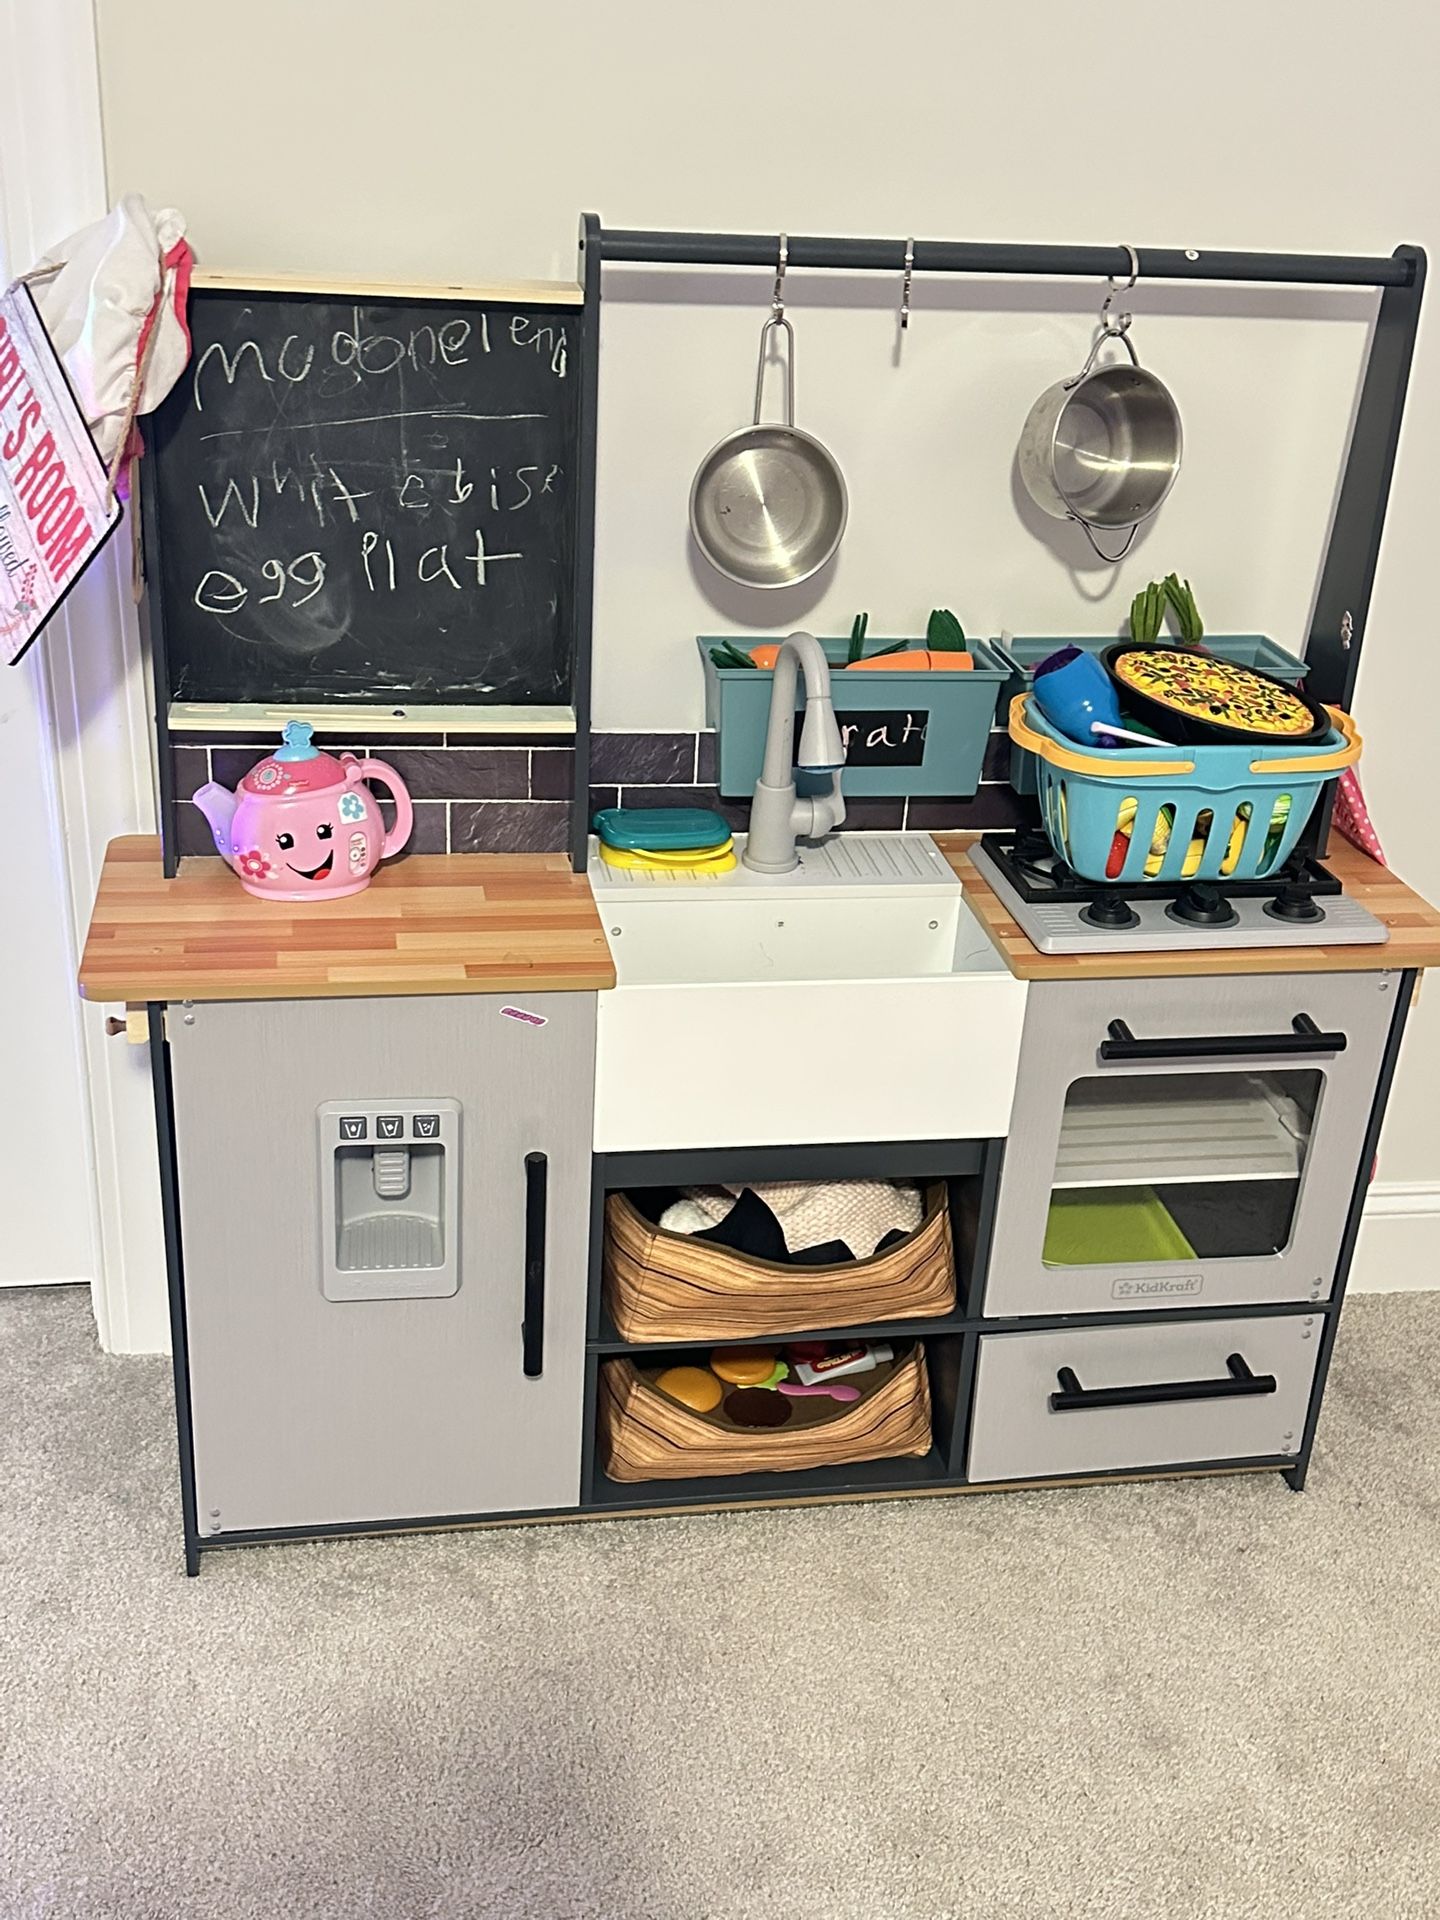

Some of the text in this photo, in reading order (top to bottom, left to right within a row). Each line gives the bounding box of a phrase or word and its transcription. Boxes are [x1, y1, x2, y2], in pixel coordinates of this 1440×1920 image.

[14, 429, 93, 584] ROOM
[194, 551, 327, 613] egg
[1135, 1279, 1196, 1294] KidKraft
